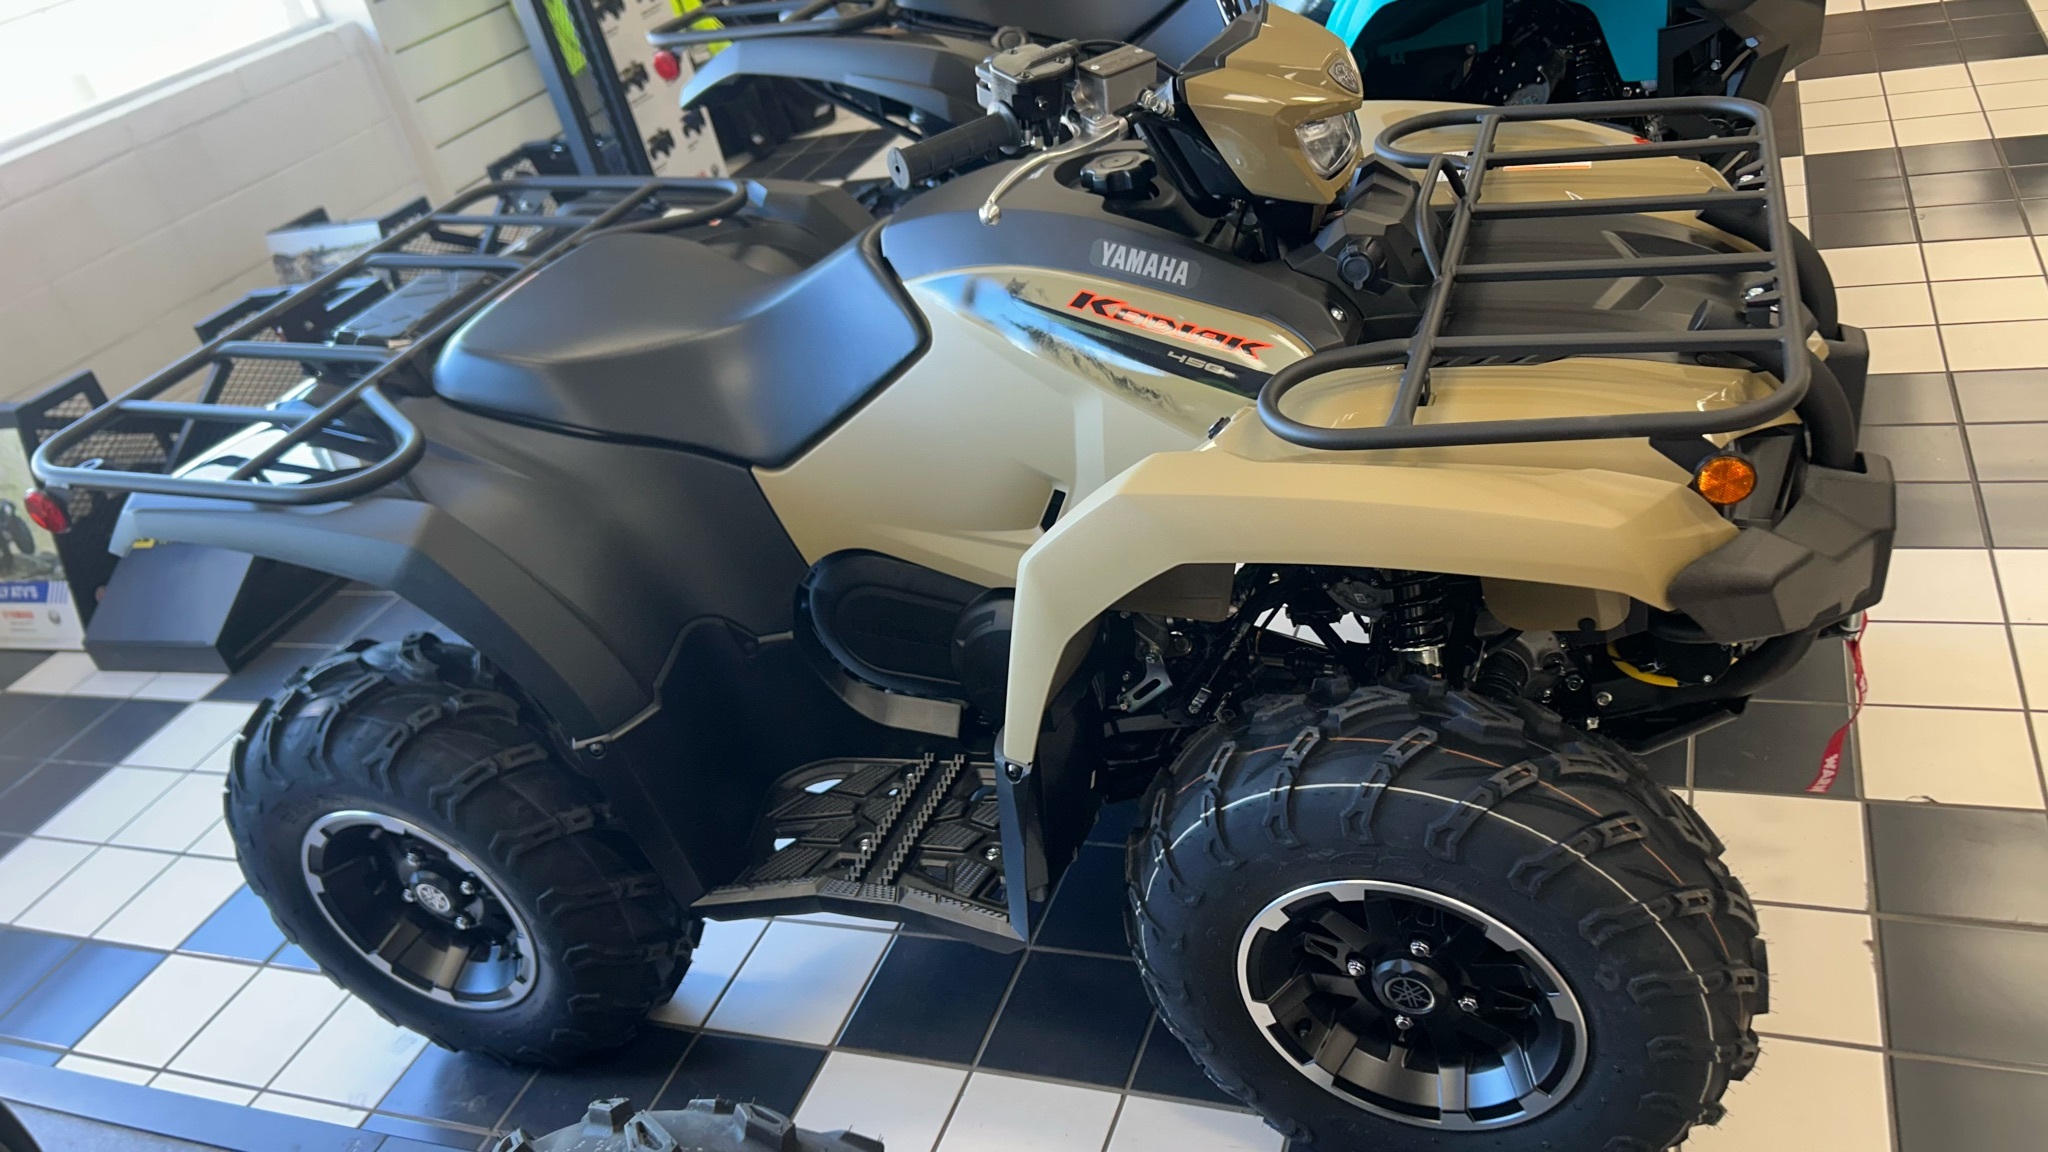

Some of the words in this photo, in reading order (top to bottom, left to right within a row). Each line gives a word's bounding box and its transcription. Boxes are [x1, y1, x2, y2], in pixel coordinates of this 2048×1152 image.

[1101, 241, 1189, 286] YAMAHA
[1067, 289, 1275, 360] KODIAK
[1167, 350, 1226, 375] 450
[1807, 753, 1839, 792] WARN
